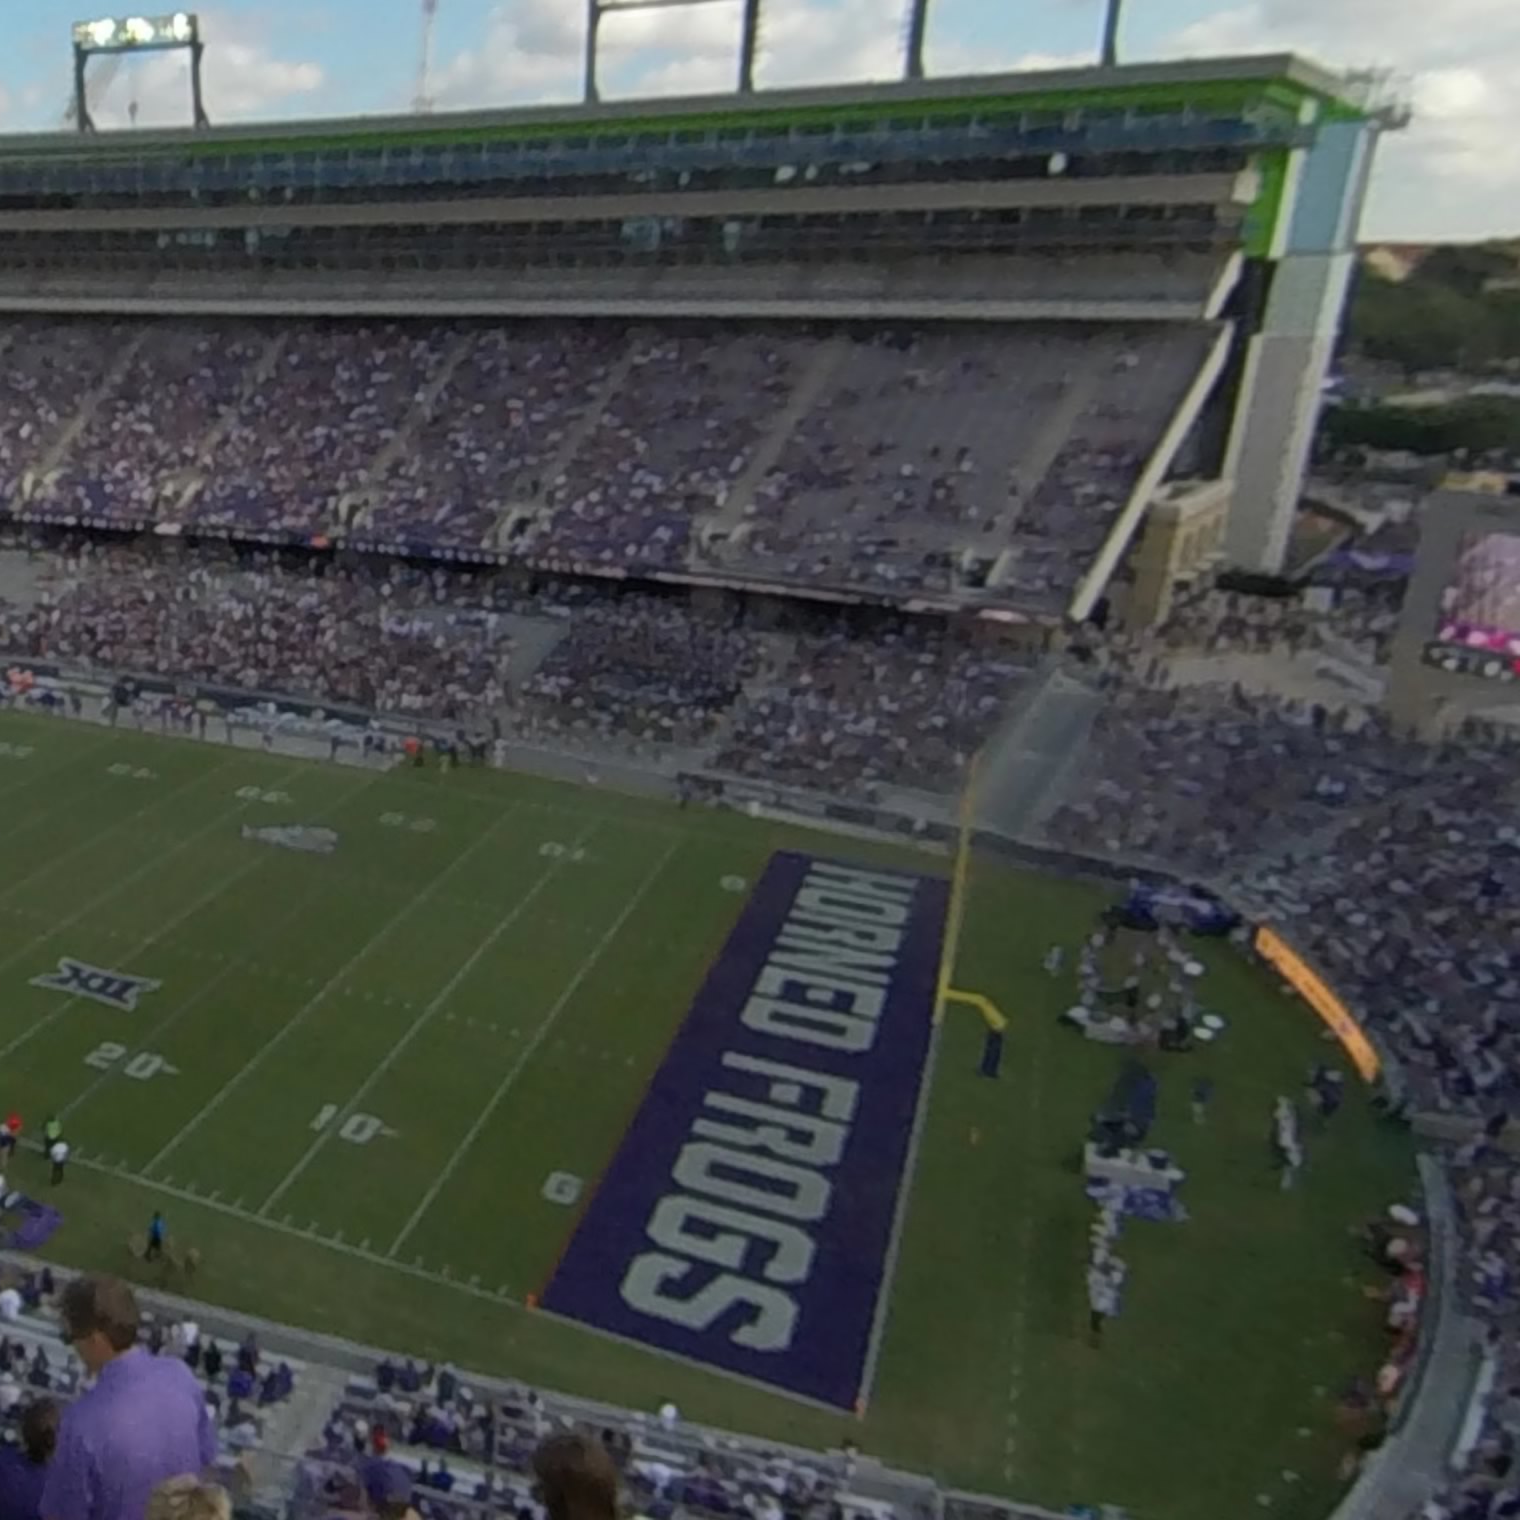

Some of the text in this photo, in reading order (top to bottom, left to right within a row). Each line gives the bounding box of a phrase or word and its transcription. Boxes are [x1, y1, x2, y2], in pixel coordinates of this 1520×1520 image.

[84, 1041, 166, 1080] 20
[309, 1103, 383, 1145] 10
[619, 860, 920, 1354] HORNED FROGS
